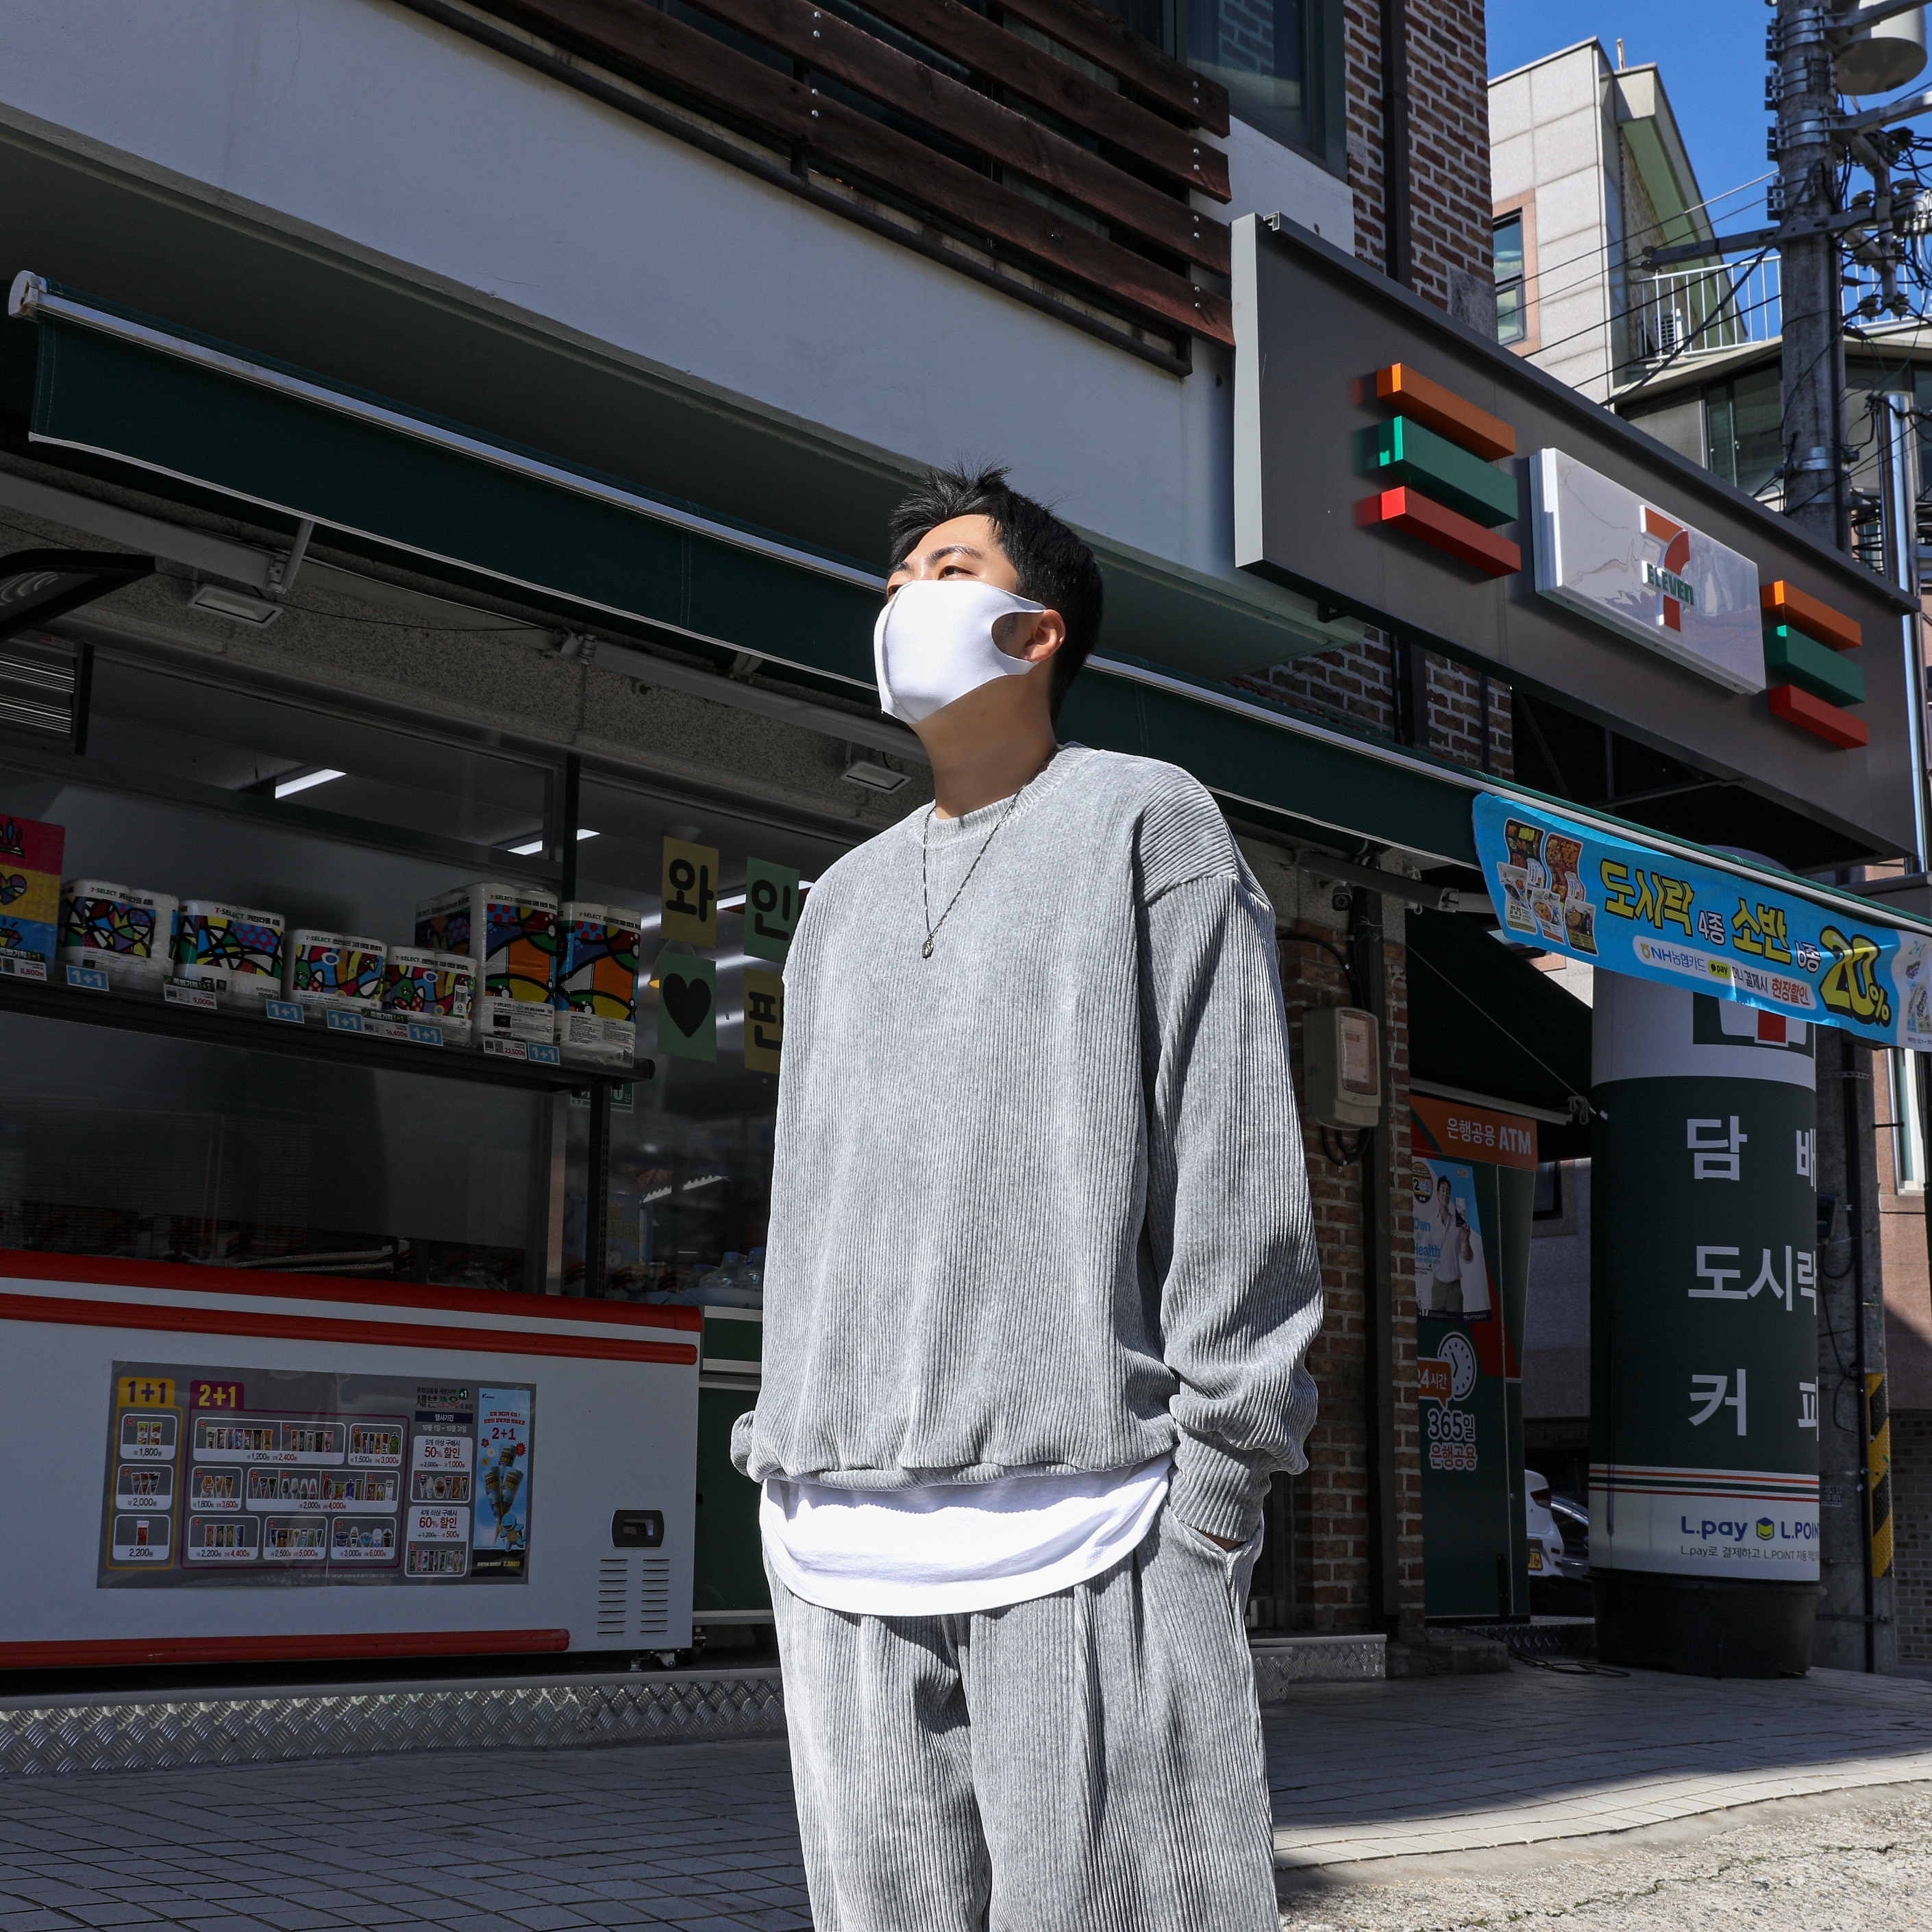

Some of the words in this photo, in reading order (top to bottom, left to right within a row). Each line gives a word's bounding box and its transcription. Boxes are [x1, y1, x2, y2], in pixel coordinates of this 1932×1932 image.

[90, 887, 116, 896] 7-SELECT
[665, 858, 714, 922] 와
[751, 879, 791, 941] 인
[215, 907, 244, 919] 7-SELECT
[1600, 858, 1695, 937] 도시락
[1698, 911, 1725, 945] 4종
[1731, 897, 1792, 965] 소반
[1795, 940, 1821, 973] 6종
[1819, 926, 1892, 1027] 20%
[27, 952, 40, 961] 1+1
[21, 967, 45, 977] 8,800원
[72, 969, 102, 987] 1+1
[1650, 947, 1706, 972] NH농협카드
[1717, 965, 1727, 975] pay
[1732, 967, 1744, 980] 머니
[1744, 971, 1768, 993] 결제시
[1772, 978, 1810, 1005] 현장할인
[198, 982, 211, 991] 1+1
[193, 997, 215, 1006] 9,000원
[271, 1003, 298, 1019] 1+1
[332, 1013, 358, 1029] 1+1
[386, 1029, 408, 1038] 16,400원
[412, 1027, 438, 1042] 1+1
[504, 1048, 525, 1056] 23,500원
[532, 1046, 555, 1061] 1+1
[1446, 1117, 1496, 1147] 은행공용
[1499, 1126, 1531, 1155] ATM
[1688, 1245, 1817, 1316] 도시락
[128, 1380, 166, 1404] 1+1
[199, 1385, 236, 1408] 2+1
[434, 1413, 455, 1422] 행사기간
[1428, 1411, 1474, 1439] 365일
[492, 1427, 516, 1440] 2+1
[424, 1446, 443, 1458] 50%
[444, 1446, 460, 1459] 할인
[1429, 1444, 1476, 1468] 은행공용
[419, 1517, 438, 1528] 60%
[440, 1517, 457, 1528] 할인
[1681, 1515, 1748, 1541] L.pay
[1681, 1546, 1718, 1558] L.pay로
[1722, 1546, 1761, 1559] 결제하고
[1763, 1550, 1795, 1561] L.POINT
